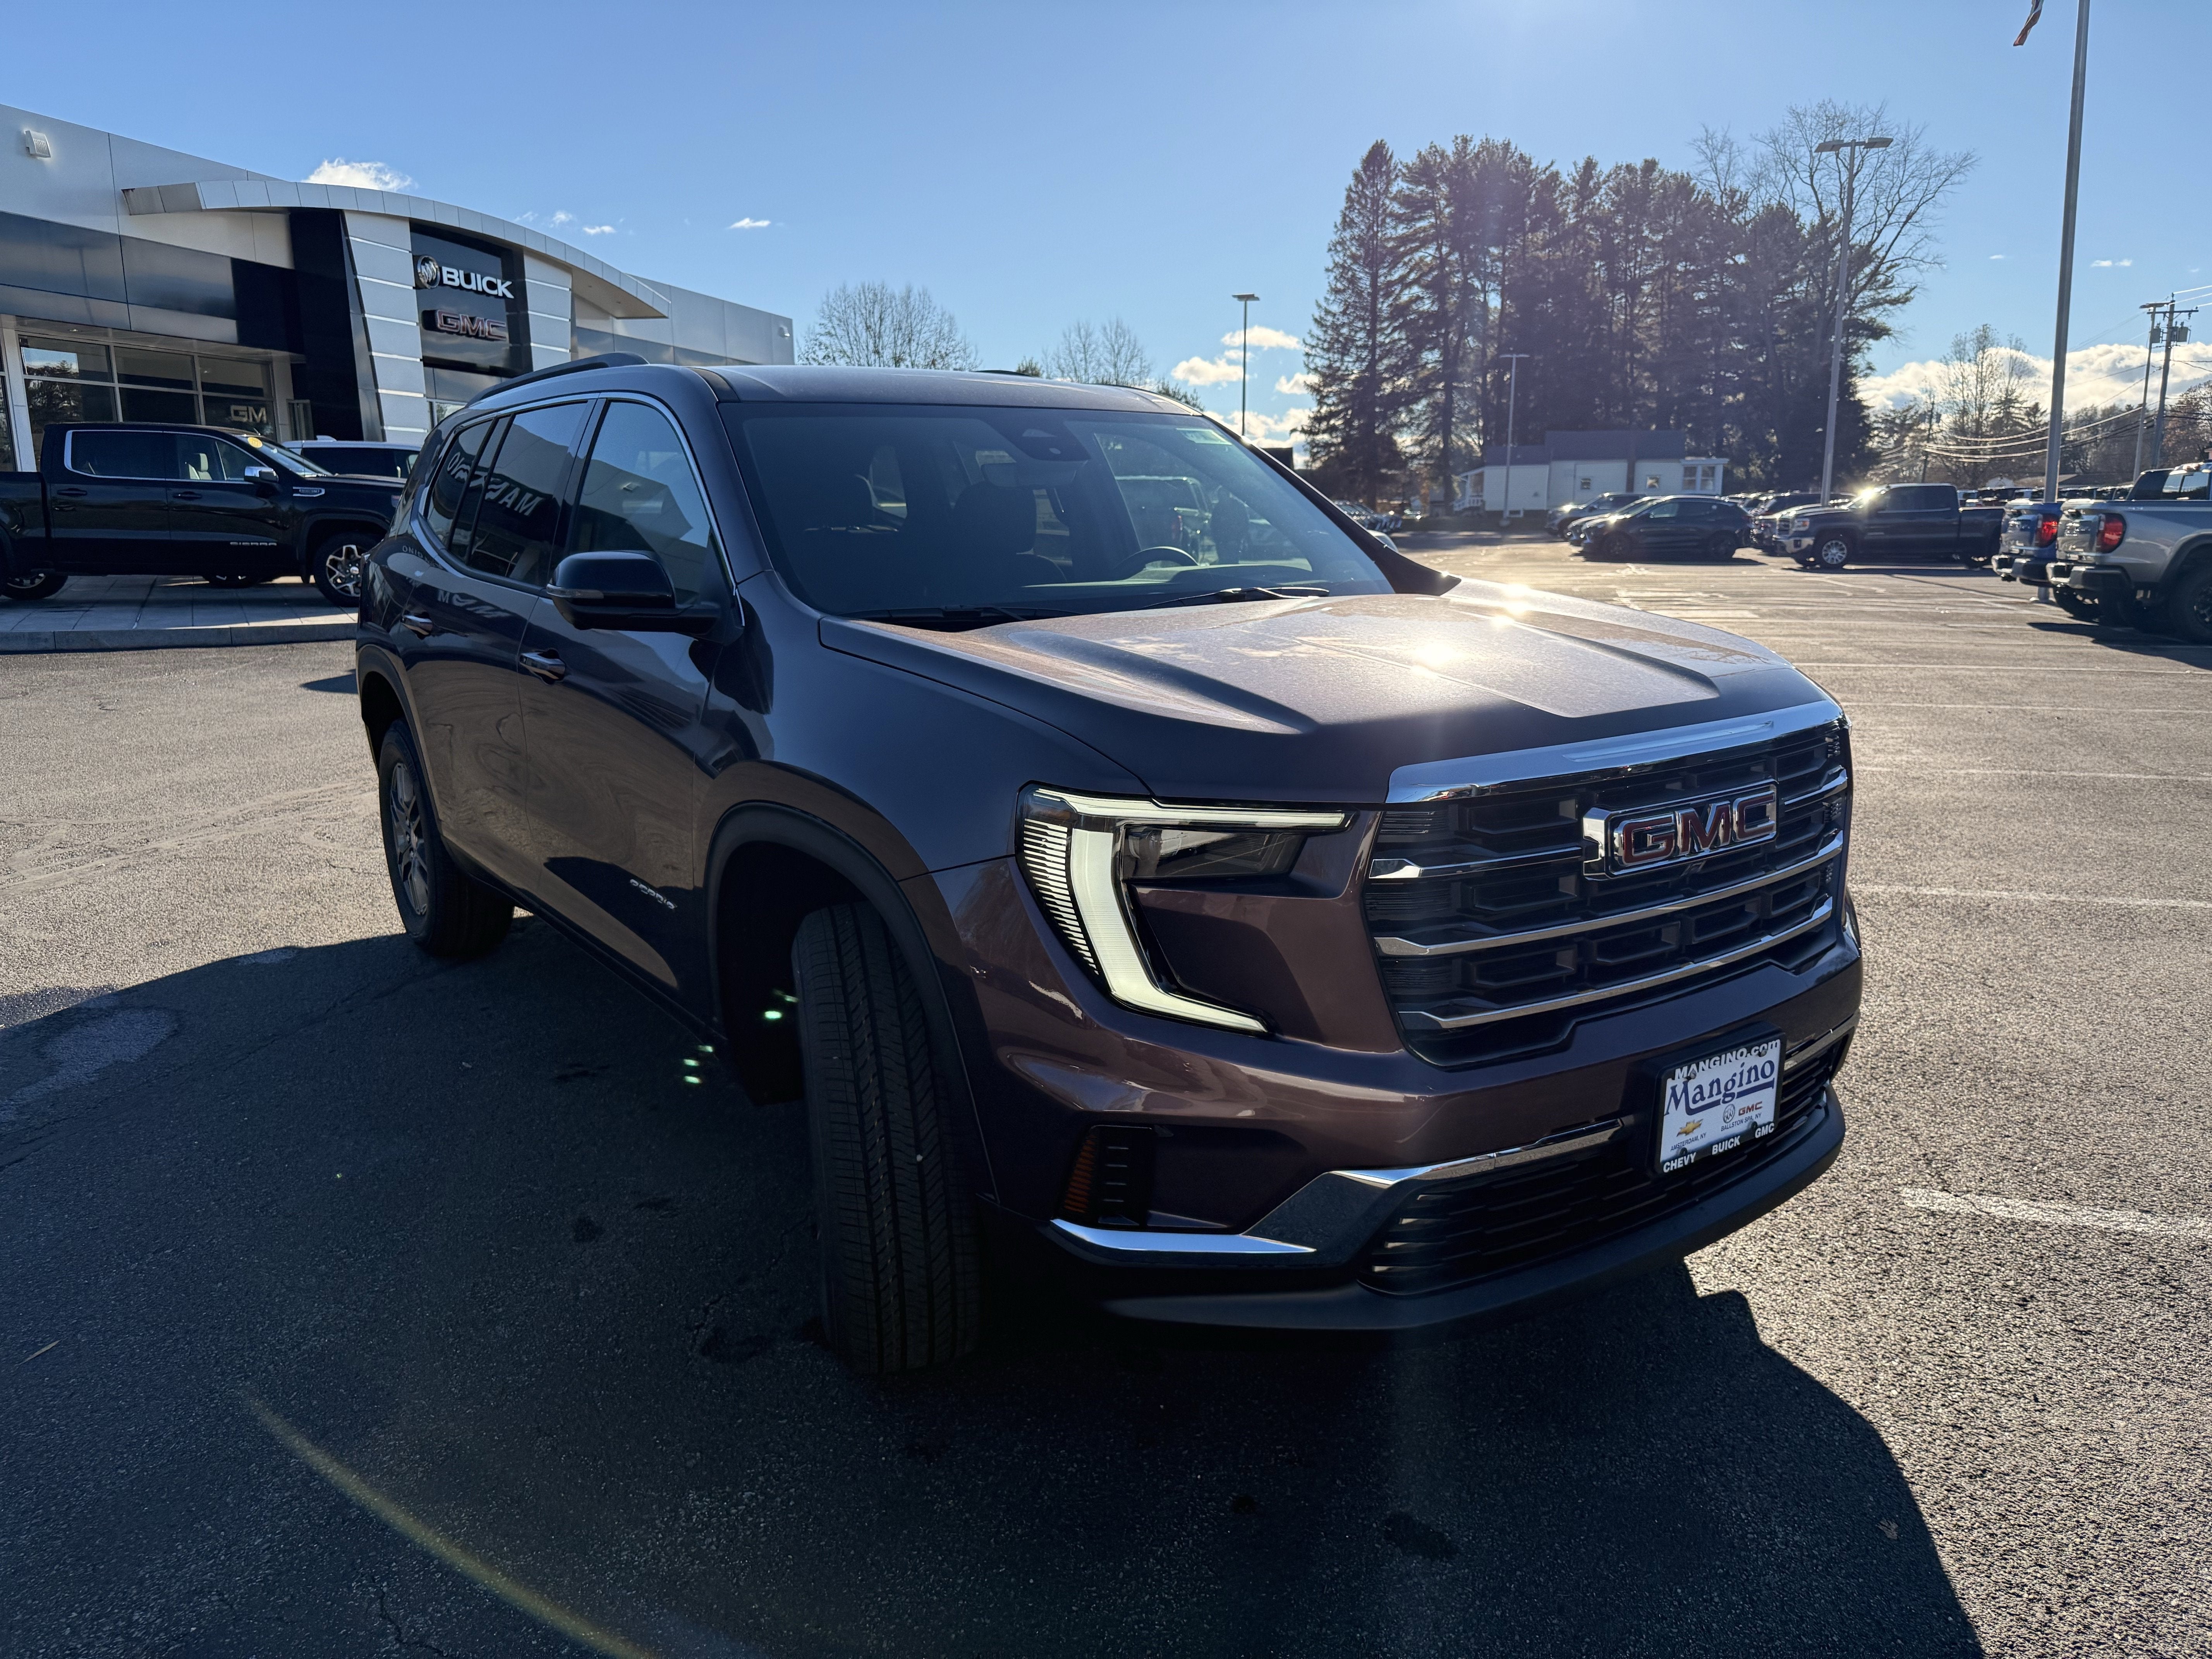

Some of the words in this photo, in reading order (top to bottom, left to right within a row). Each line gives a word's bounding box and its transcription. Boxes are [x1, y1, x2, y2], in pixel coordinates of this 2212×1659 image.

[441, 266, 514, 299] BUICK
[436, 309, 507, 340] GMC
[230, 405, 267, 423] GM
[1614, 790, 1776, 866] GMC
[1664, 1060, 1775, 1116] Mangino
[1738, 1101, 1763, 1116] GMC
[1721, 1118, 1744, 1132] BALLSTON
[1663, 1152, 1697, 1173] CHEVY
[1712, 1135, 1740, 1155] BUICK
[1755, 1123, 1774, 1139] GMC
